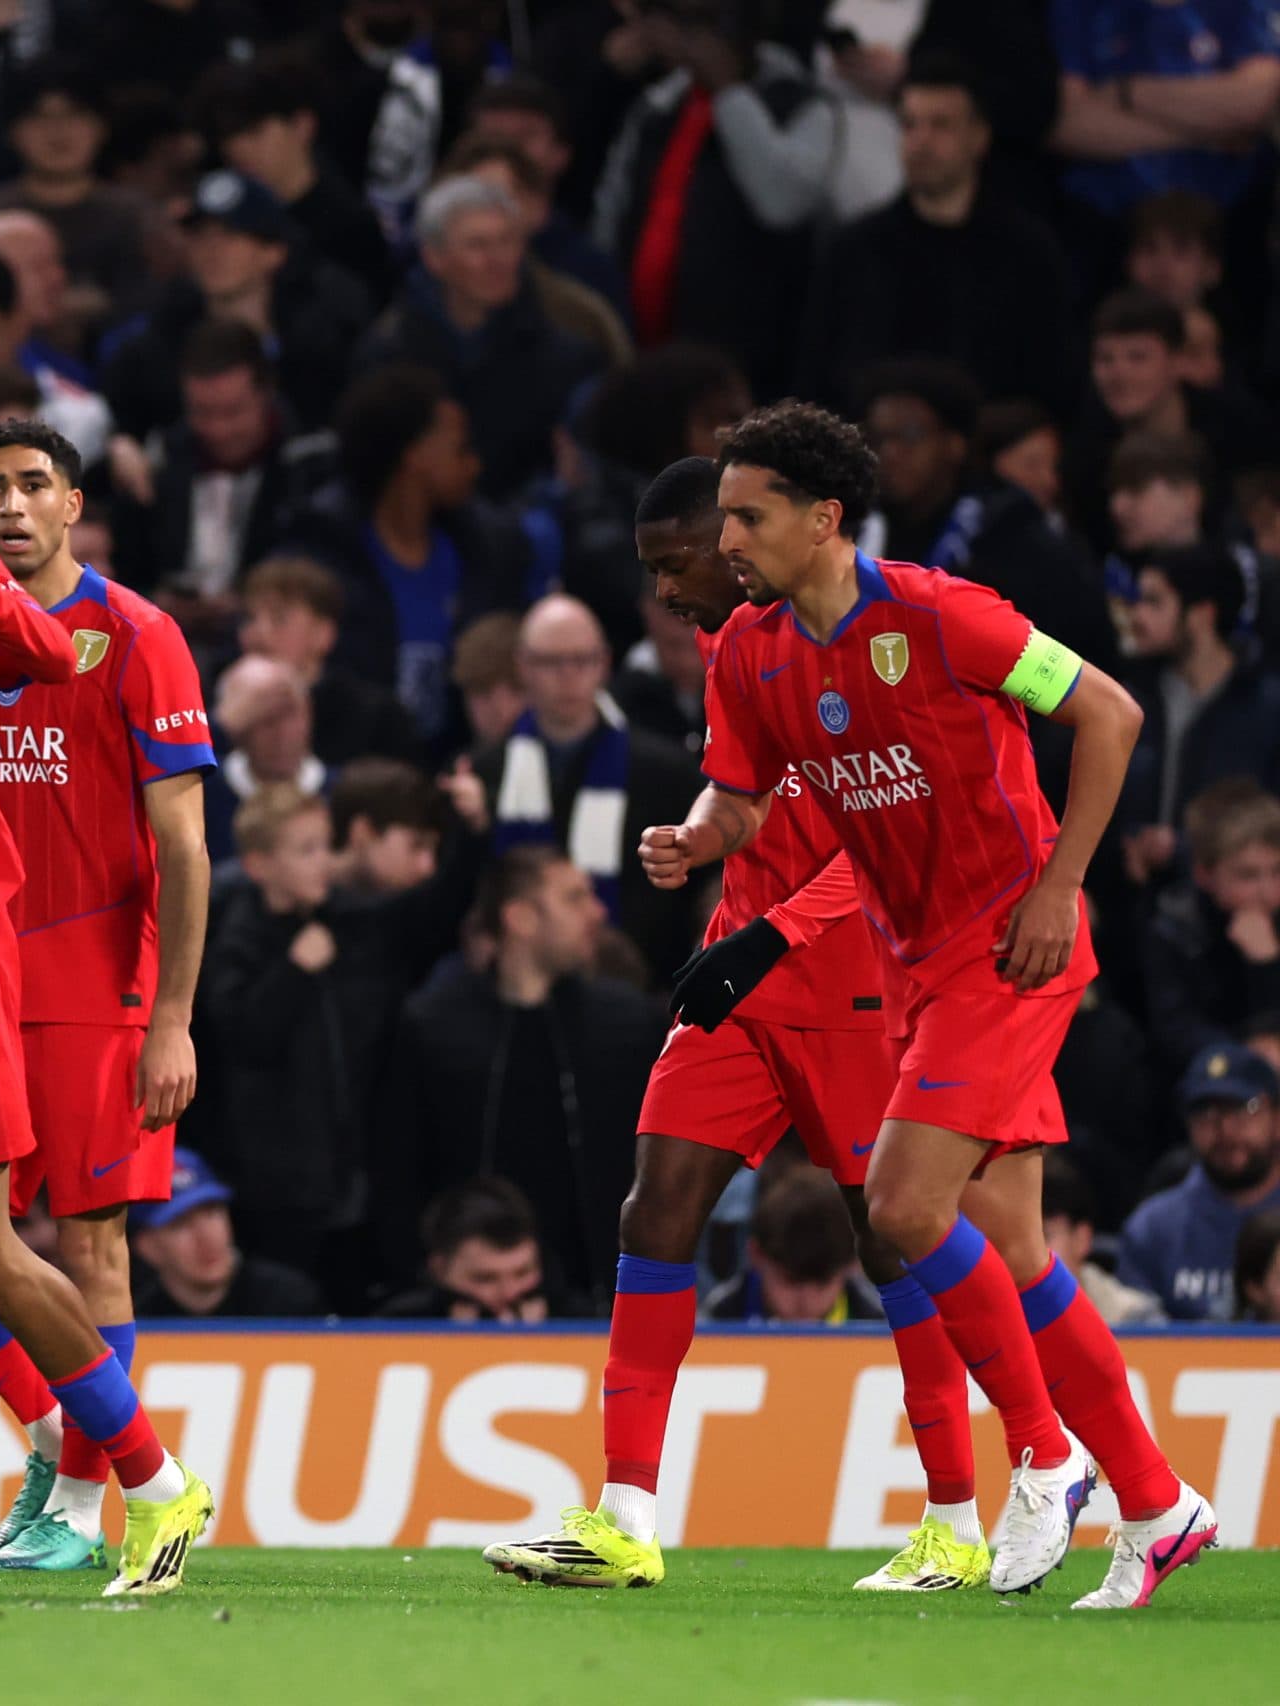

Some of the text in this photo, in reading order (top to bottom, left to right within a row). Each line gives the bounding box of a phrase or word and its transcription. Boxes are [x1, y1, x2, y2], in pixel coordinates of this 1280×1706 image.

[801, 744, 923, 797] QATAR
[843, 776, 932, 812] AIRWAYS
[141, 1361, 767, 1546] JUST
